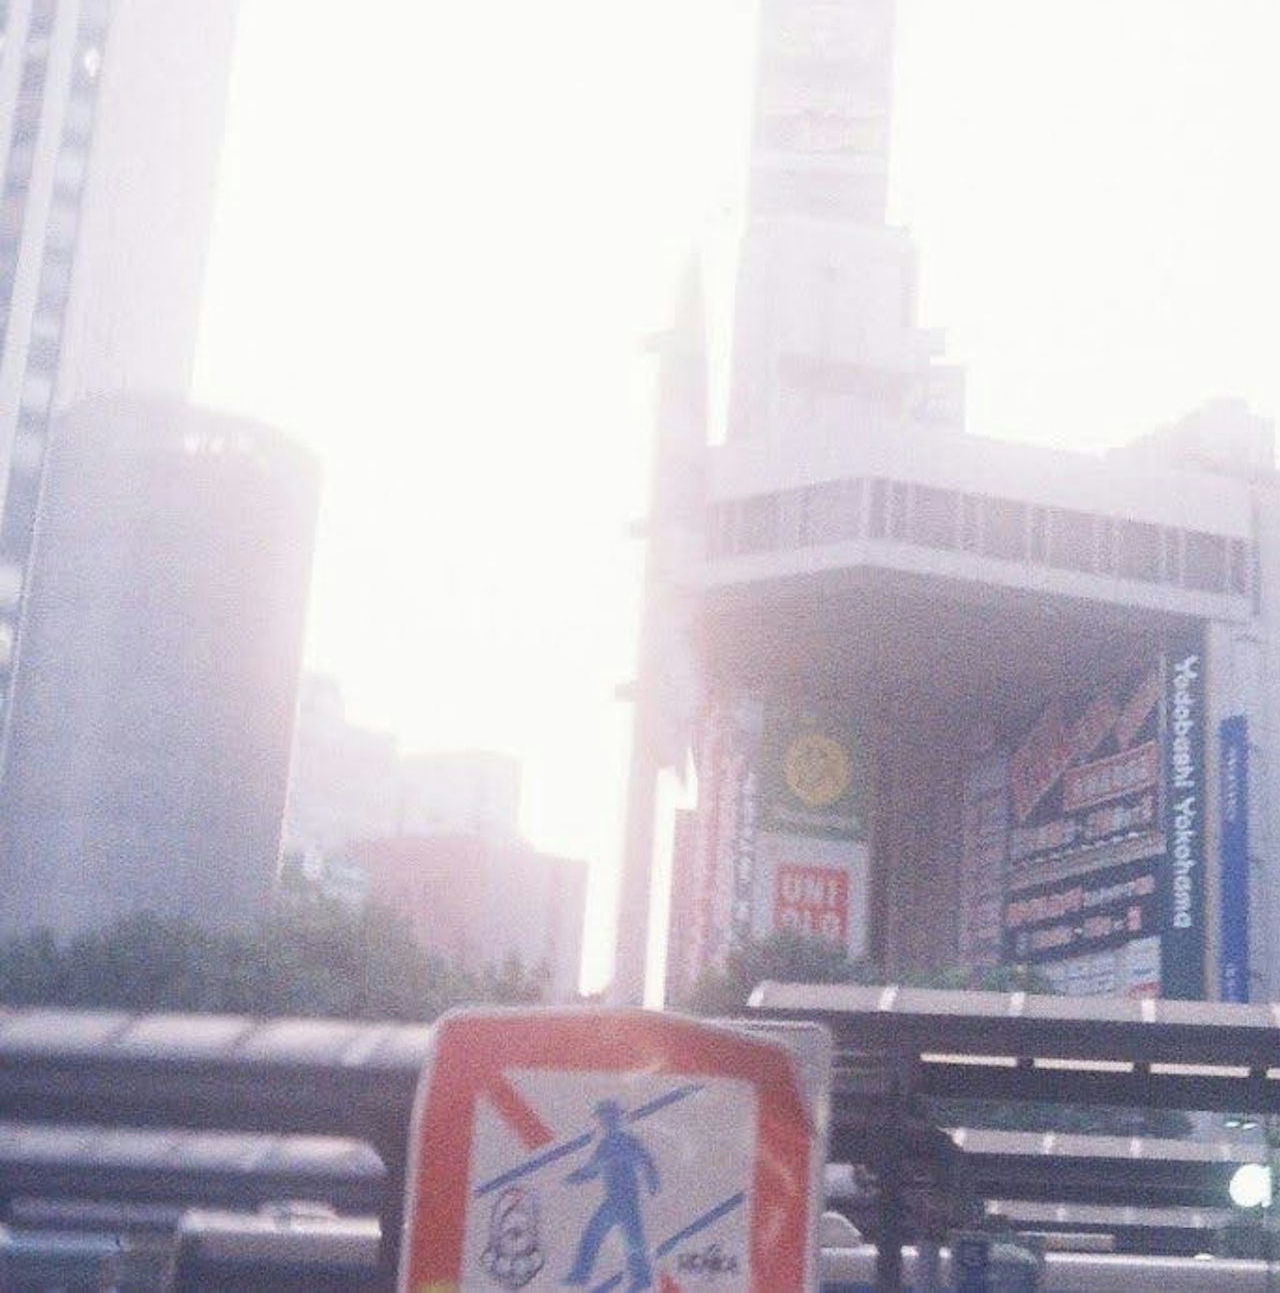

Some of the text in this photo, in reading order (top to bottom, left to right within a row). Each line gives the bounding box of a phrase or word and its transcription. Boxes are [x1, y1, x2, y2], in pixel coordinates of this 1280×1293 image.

[1172, 654, 1200, 930] Yodobashi Yokohama
[781, 872, 840, 907] UNI
